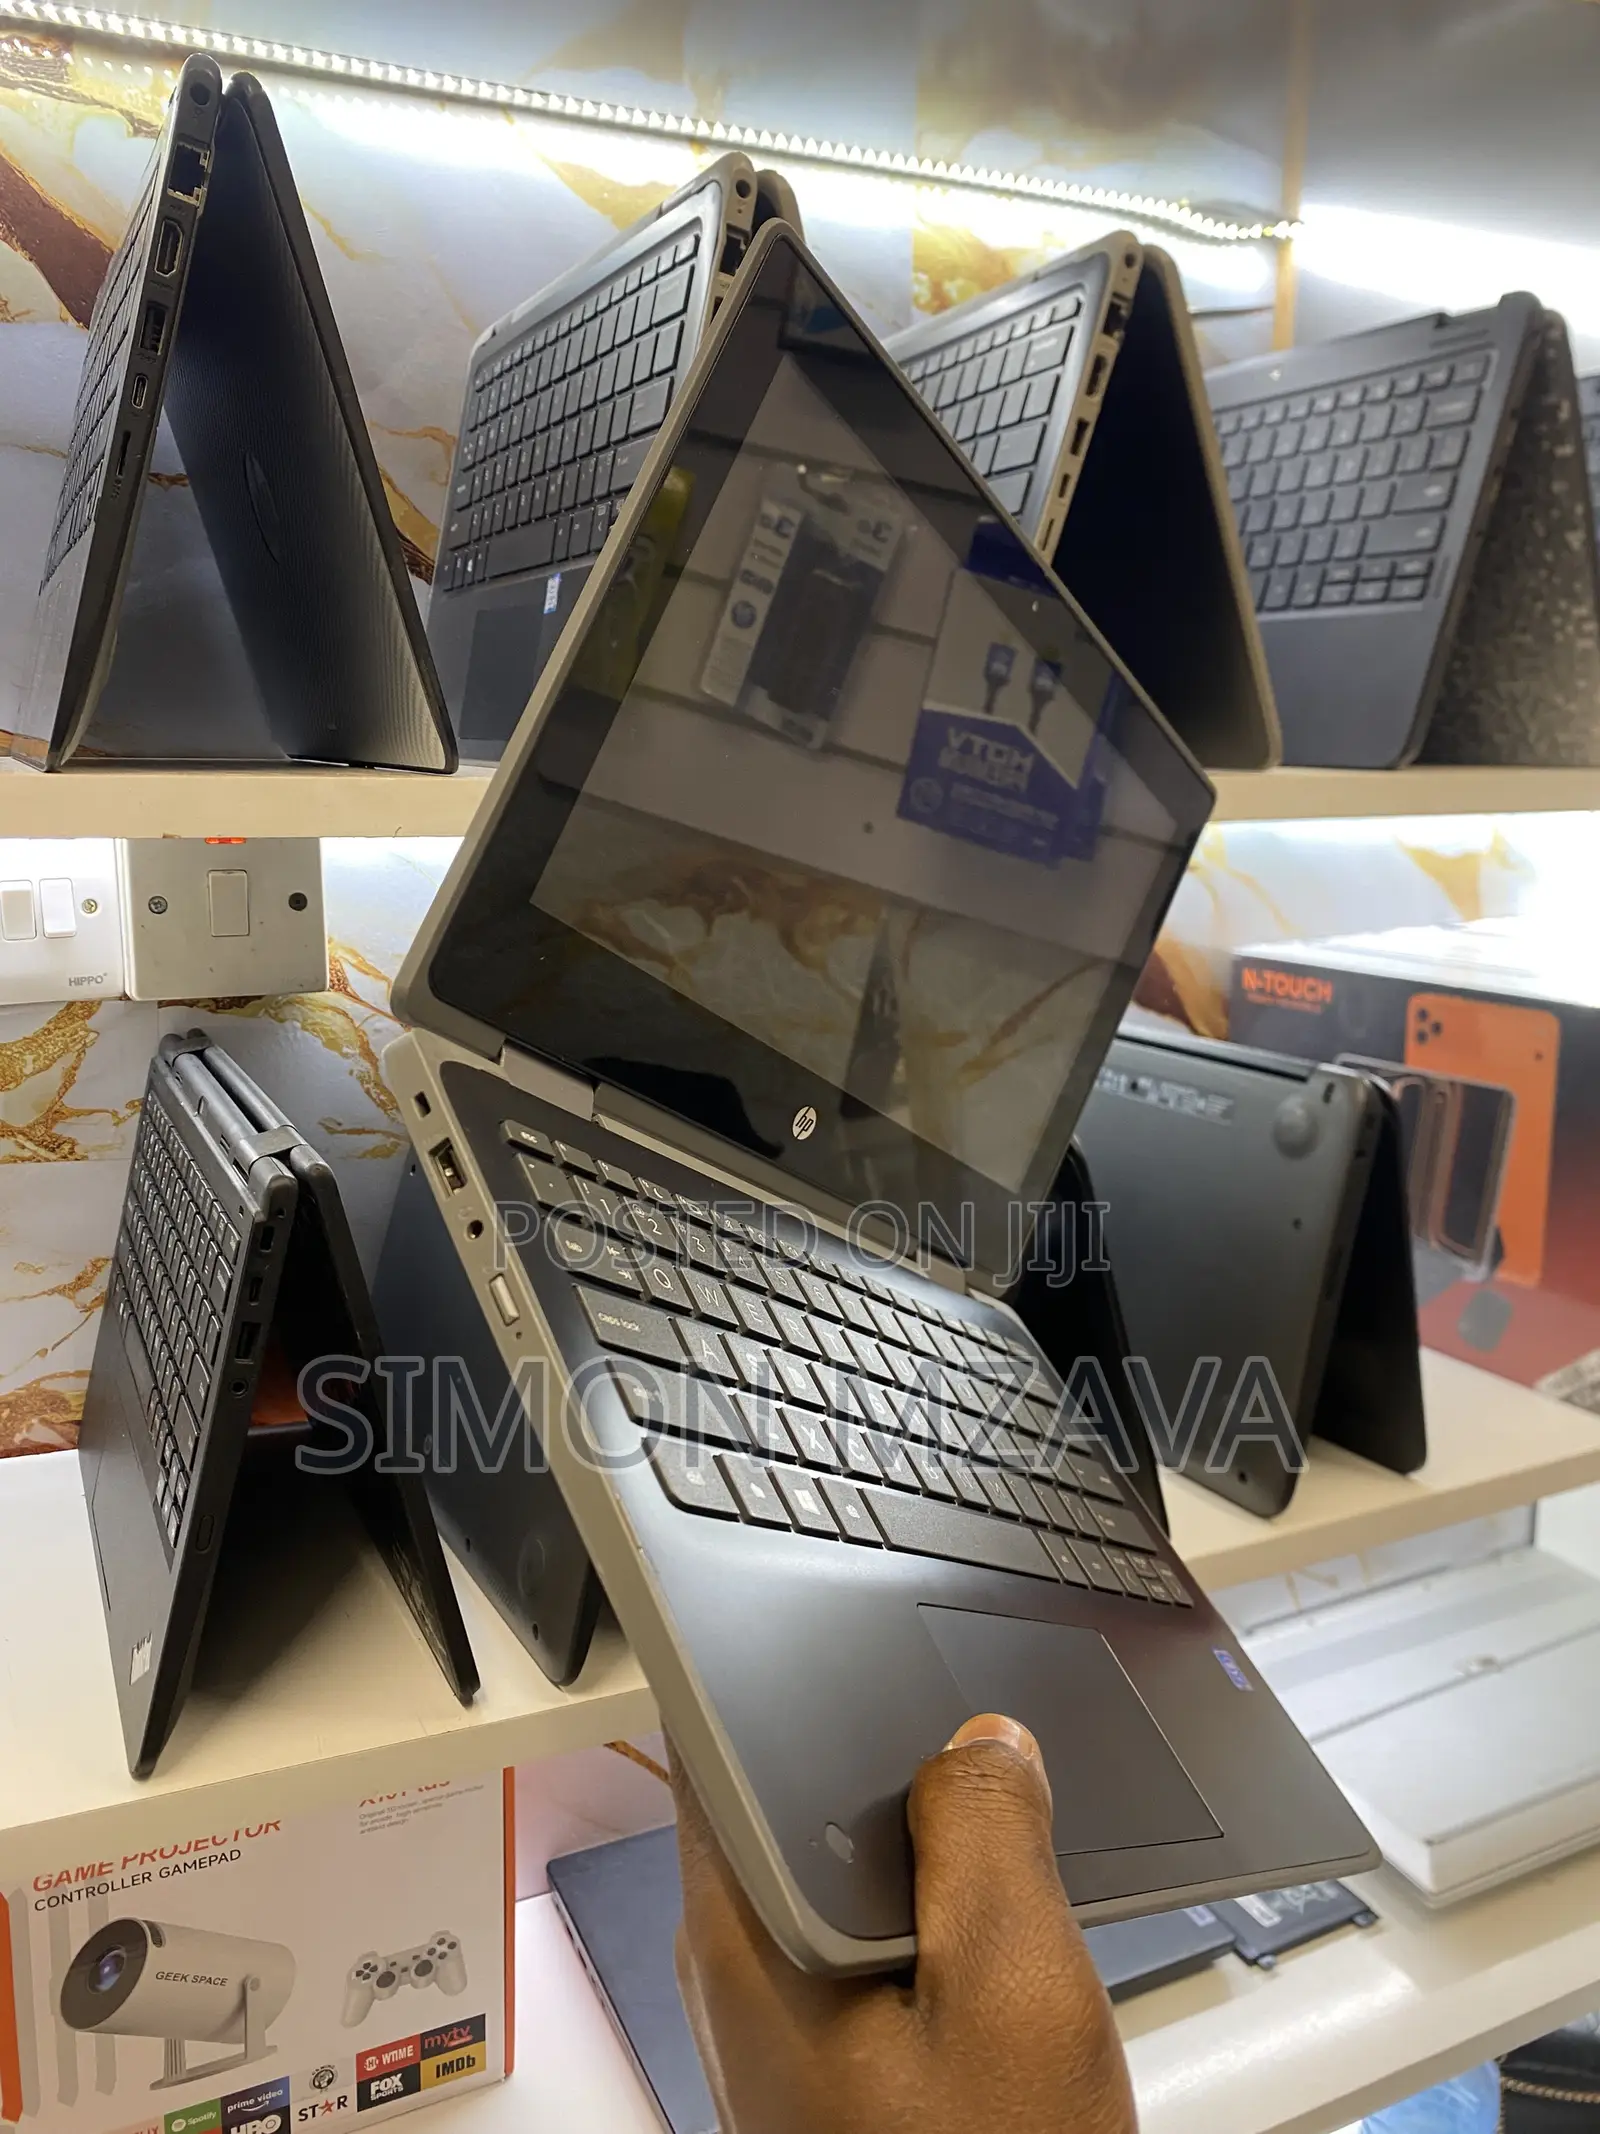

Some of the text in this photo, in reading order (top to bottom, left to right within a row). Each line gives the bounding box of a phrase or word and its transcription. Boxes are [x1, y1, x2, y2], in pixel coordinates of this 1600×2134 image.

[69, 975, 104, 987] HIPPO
[793, 1106, 817, 1140] hp
[647, 1218, 662, 1235] 2
[692, 1236, 706, 1253] 3
[654, 1268, 674, 1290] Q
[697, 1284, 719, 1306] W
[746, 1303, 762, 1323] E
[786, 1318, 804, 1338] R
[824, 1331, 839, 1352] T
[702, 1339, 720, 1363] A
[801, 1425, 825, 1452] X
[33, 1861, 114, 1892] GAME
[34, 1849, 242, 1912] CONTROLLER GAMEPAD
[155, 1971, 228, 1987] GEEK SPACE
[370, 2073, 403, 2094] FOX
[370, 2086, 404, 2101] SPORTS
[227, 2088, 284, 2114] prime video
[187, 2109, 217, 2127] Spotify
